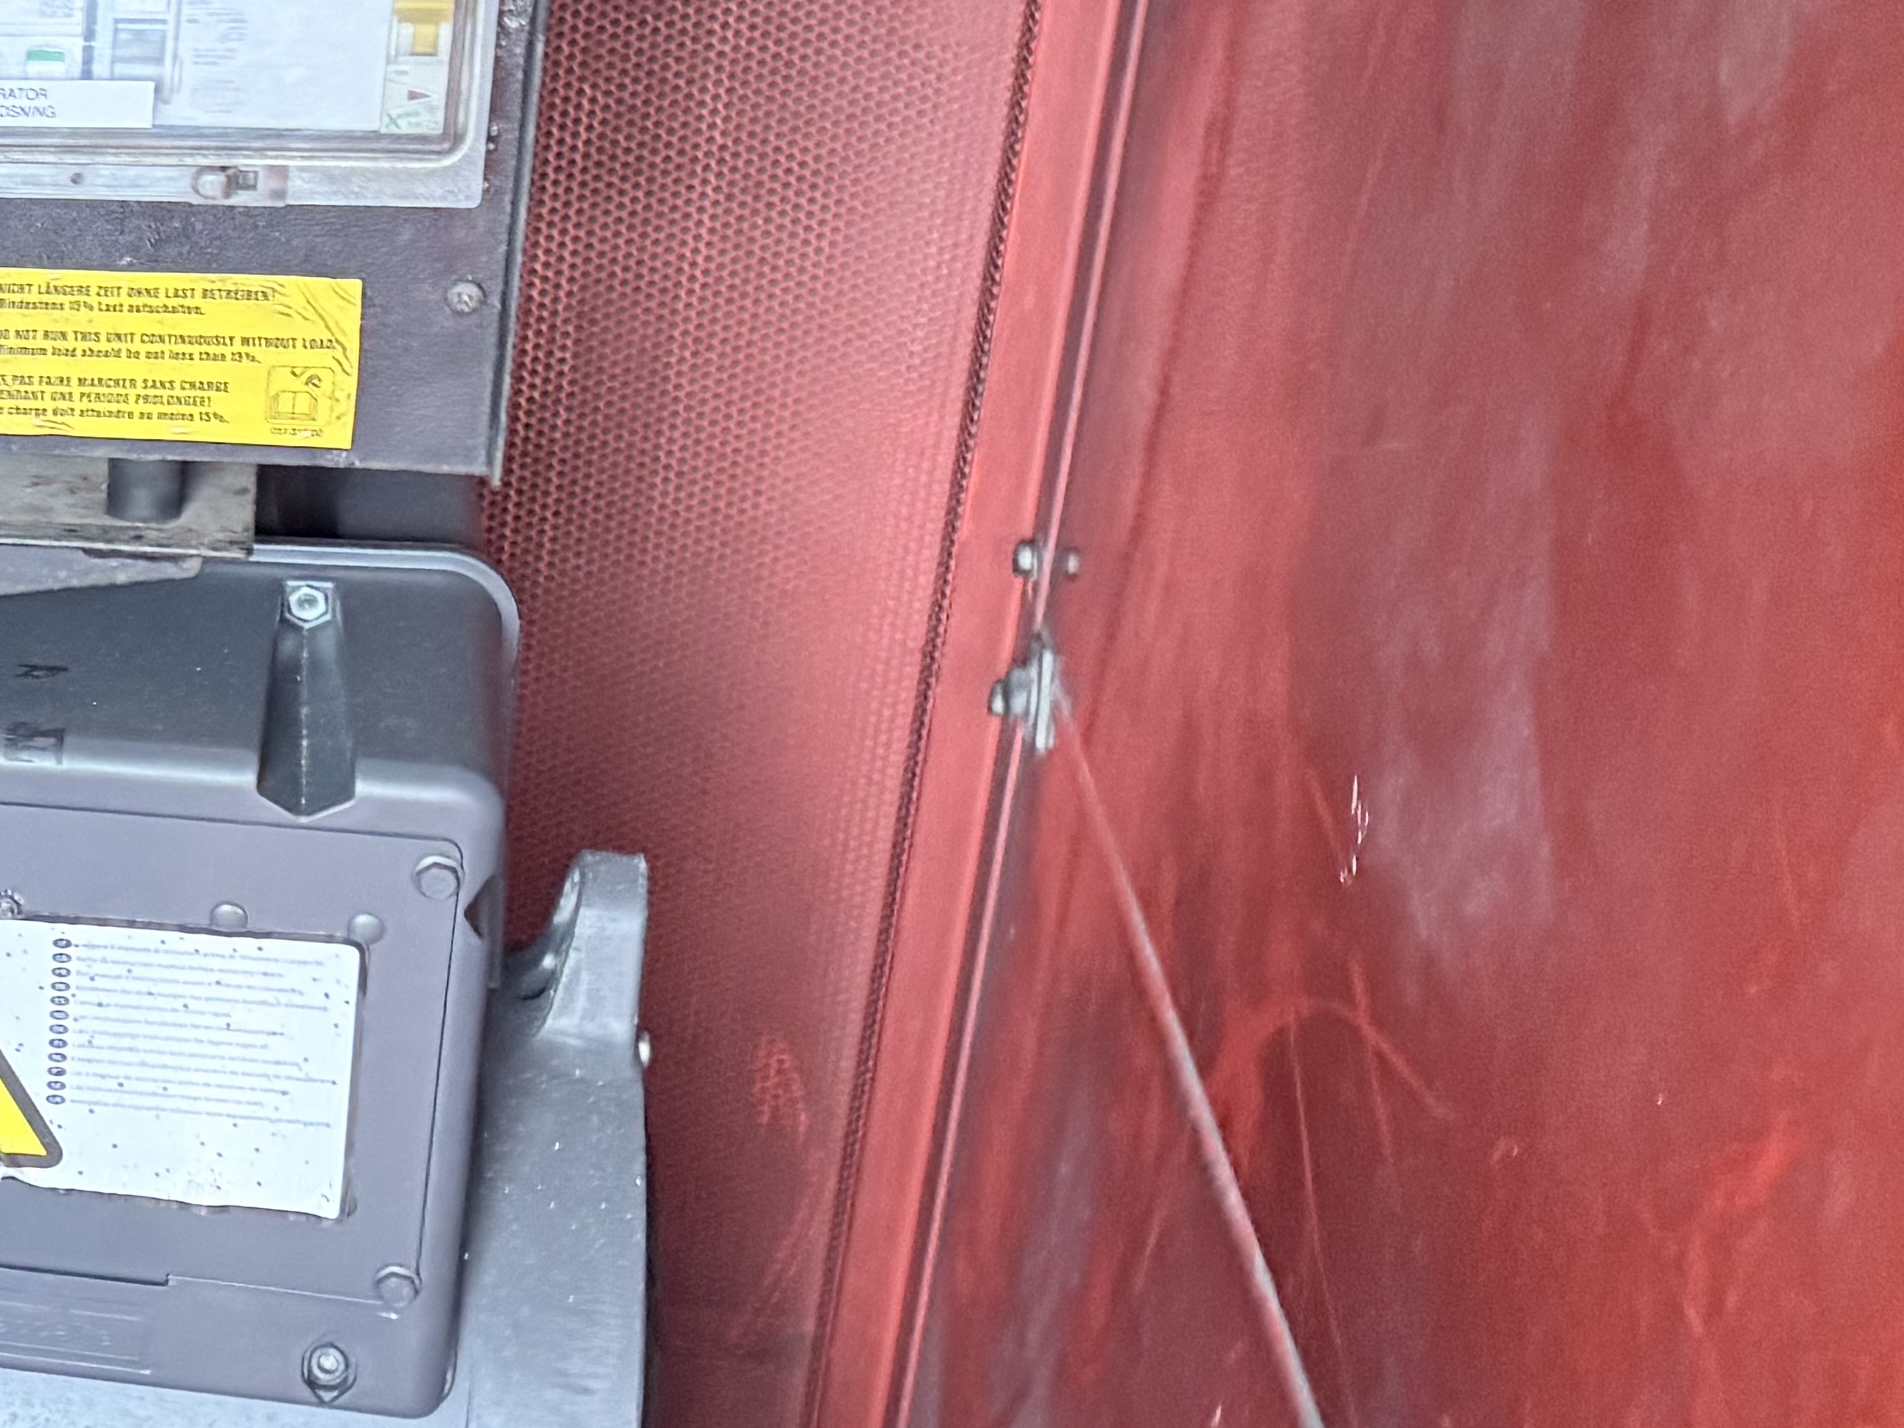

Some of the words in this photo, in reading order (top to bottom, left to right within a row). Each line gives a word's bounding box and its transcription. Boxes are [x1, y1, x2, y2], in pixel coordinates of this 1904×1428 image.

[96, 284, 122, 298] ZEIT
[164, 286, 196, 299] LAST
[15, 329, 38, 342] NOT
[43, 330, 69, 343] RUN
[74, 331, 101, 344] THIS
[106, 332, 134, 345] UNIT
[140, 333, 236, 348] CONTINUOUSLY
[240, 336, 296, 349] WITHOUT
[51, 346, 77, 357] load
[11, 375, 33, 386] PAS
[38, 375, 71, 387] FAIRE
[77, 377, 138, 390] MARCHER
[142, 378, 175, 390] SANS
[180, 379, 231, 393] CHARGE
